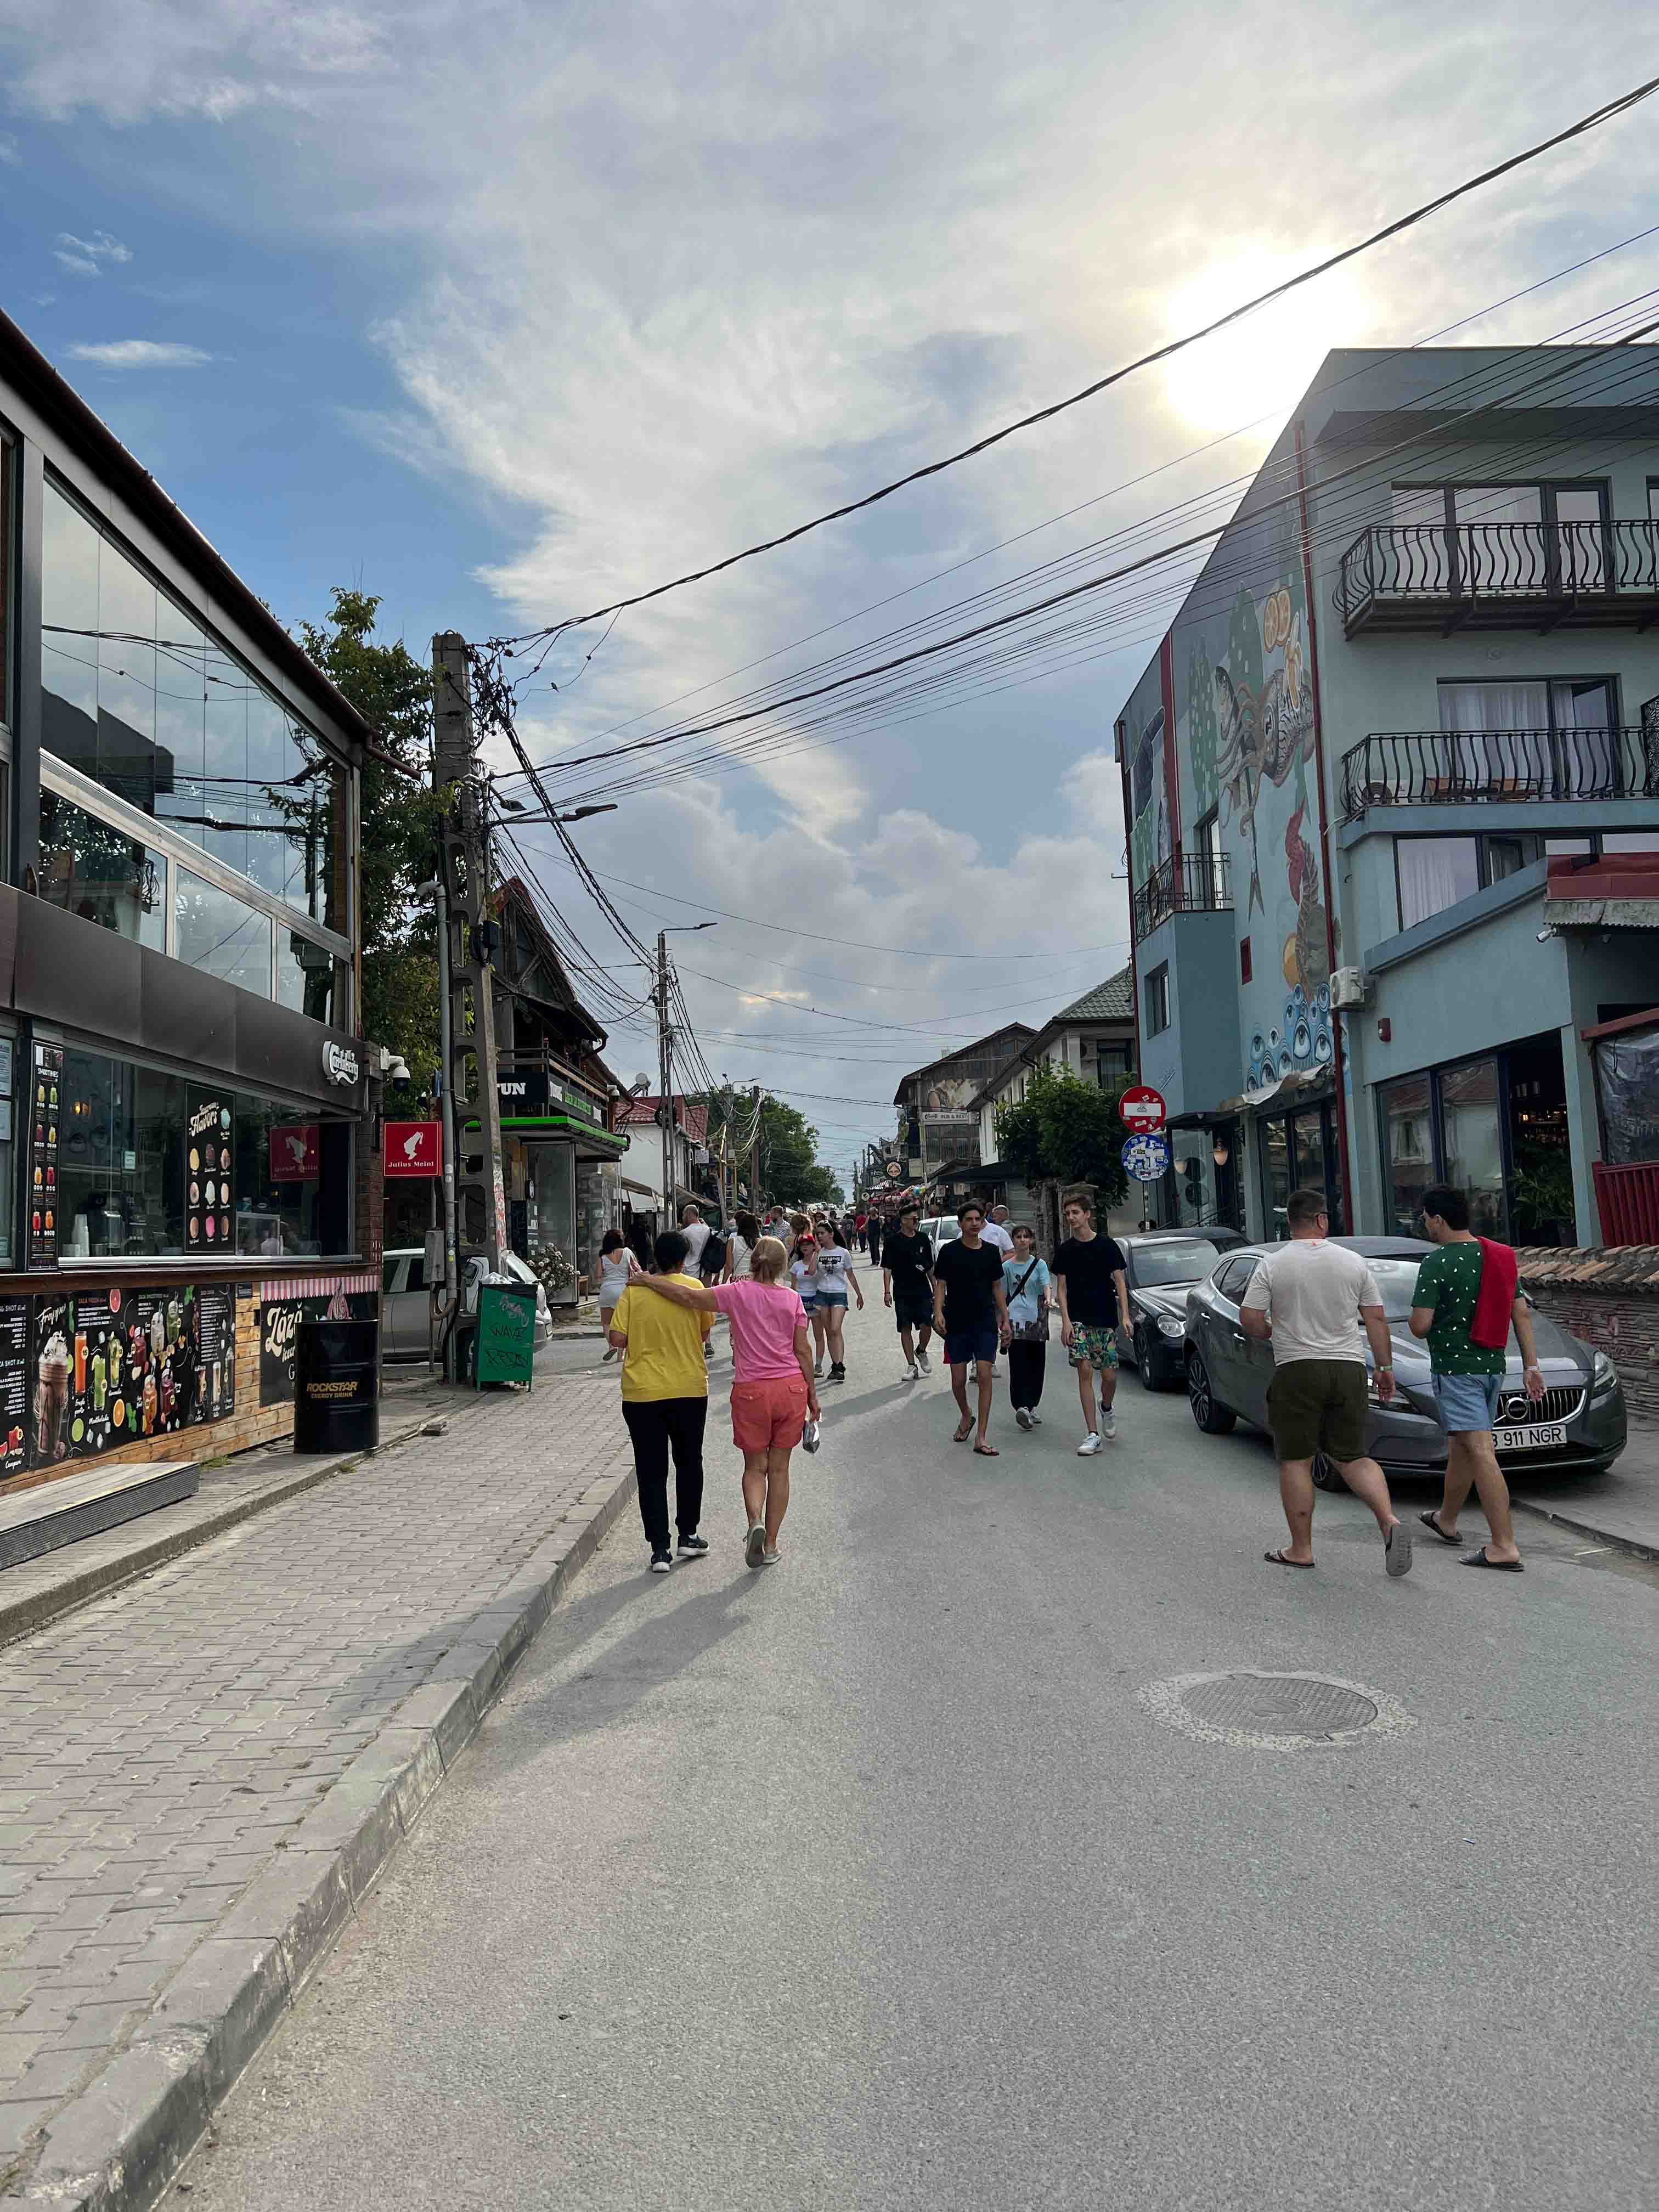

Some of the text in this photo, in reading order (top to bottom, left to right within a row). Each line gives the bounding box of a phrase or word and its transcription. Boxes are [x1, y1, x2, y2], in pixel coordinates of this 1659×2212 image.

[496, 1082, 527, 1096] UN
[190, 1110, 218, 1137] Flavors
[307, 1381, 359, 1392] ROCKSTAR
[1504, 1430, 1524, 1447] 911
[1529, 1427, 1562, 1445] NGR
